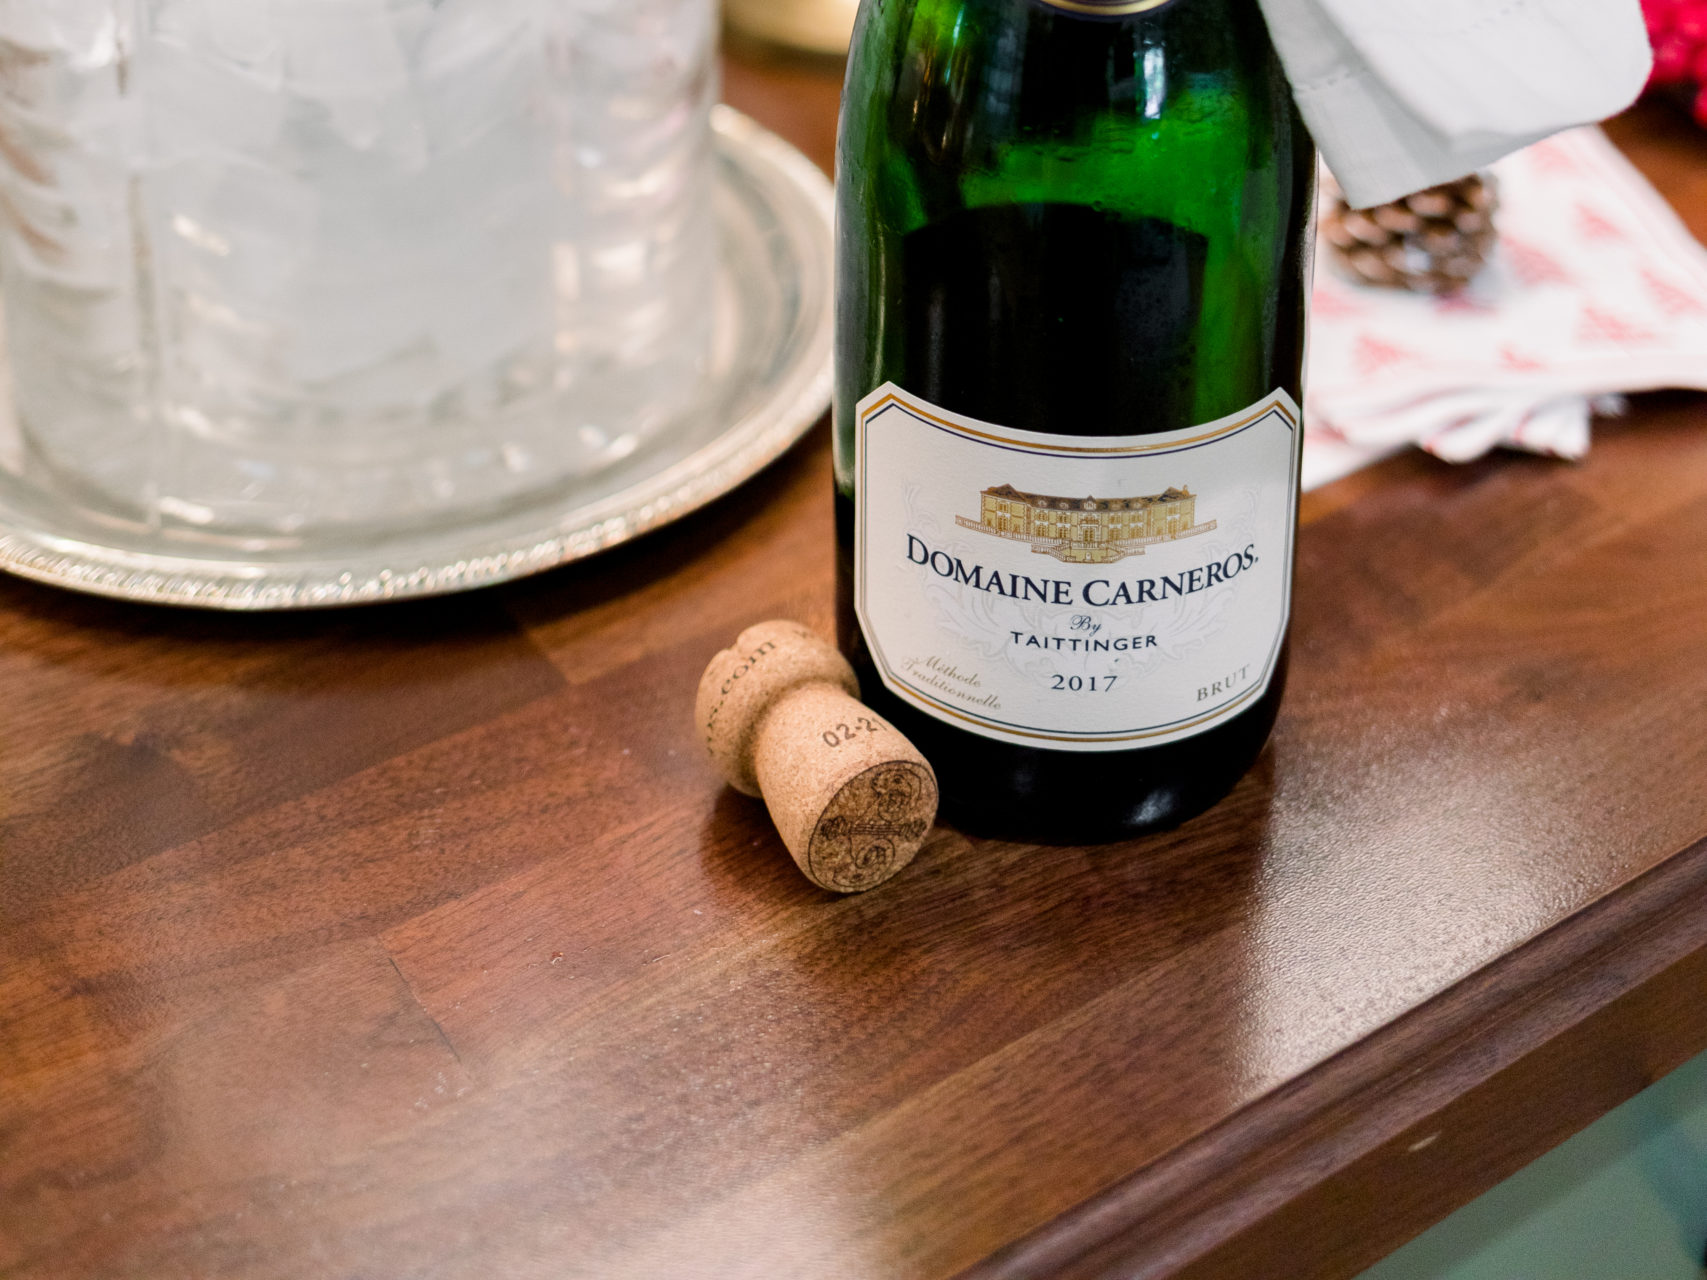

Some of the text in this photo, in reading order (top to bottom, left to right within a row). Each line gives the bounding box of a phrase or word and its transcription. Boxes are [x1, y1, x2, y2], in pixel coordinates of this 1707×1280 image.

[906, 533, 1074, 605] DOMAINE
[1070, 614, 1102, 637] By
[1010, 631, 1158, 652] TAITTINGER
[1051, 674, 1118, 692] 2017
[1196, 663, 1251, 702] BRUT
